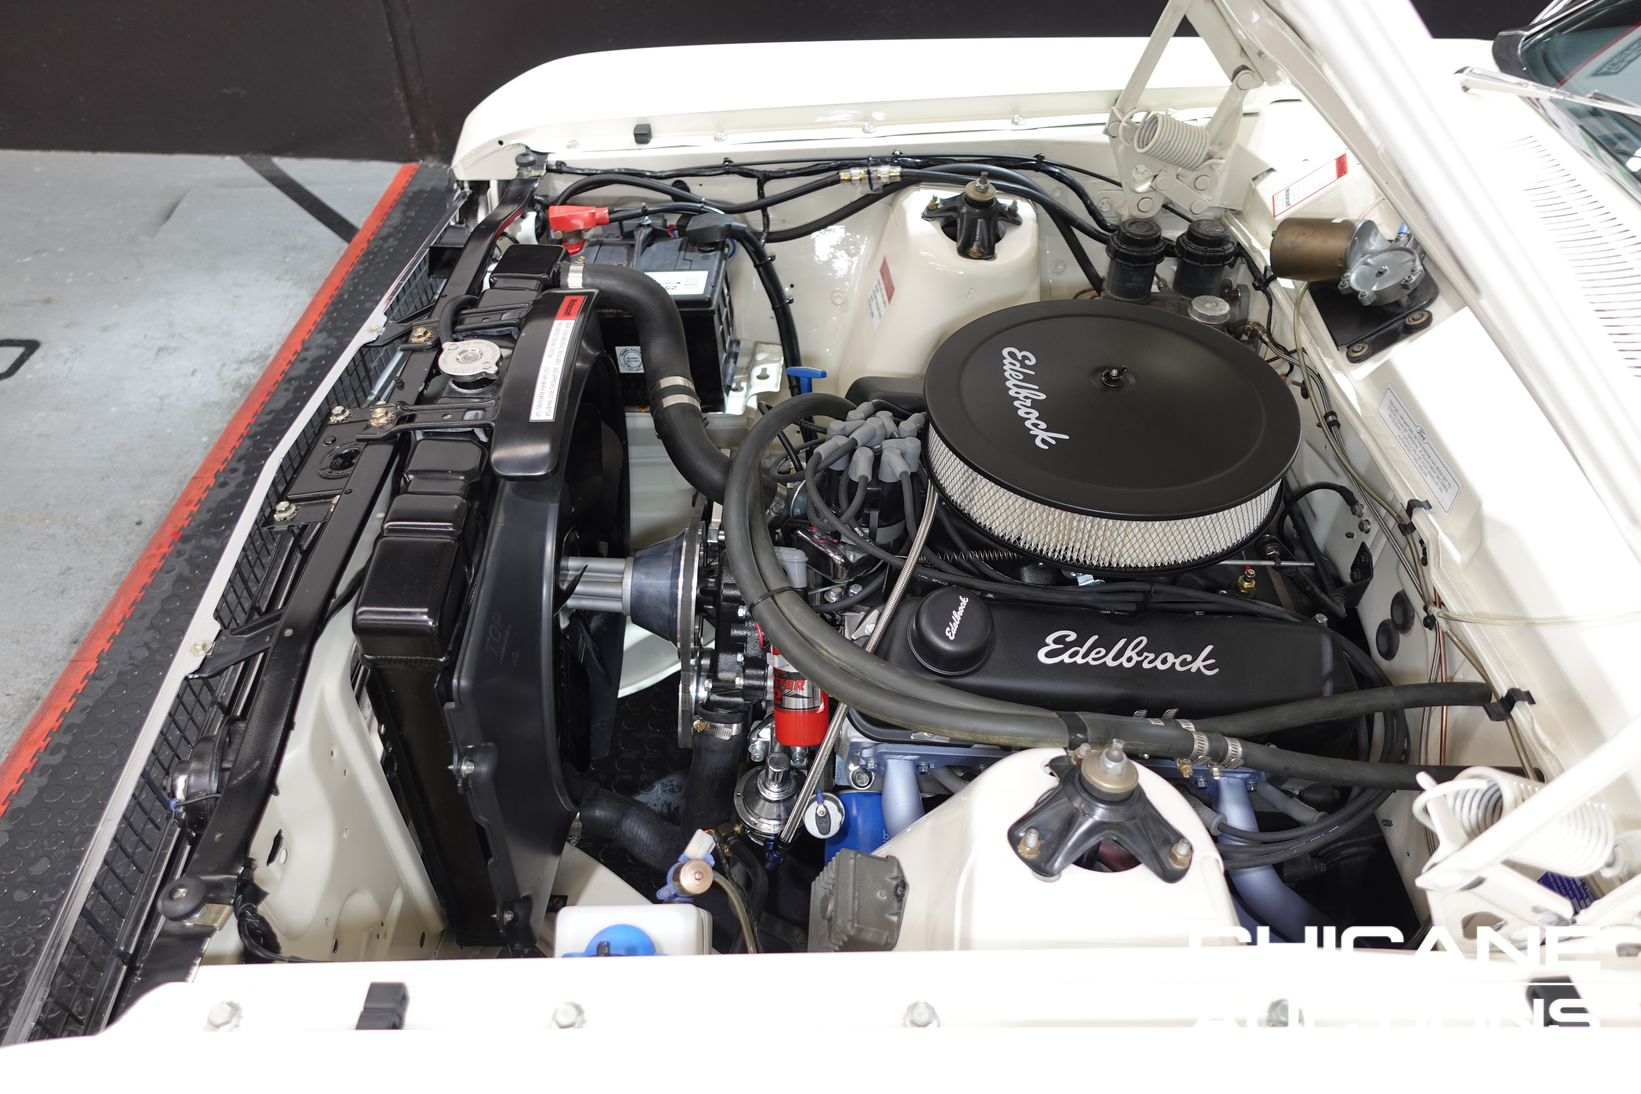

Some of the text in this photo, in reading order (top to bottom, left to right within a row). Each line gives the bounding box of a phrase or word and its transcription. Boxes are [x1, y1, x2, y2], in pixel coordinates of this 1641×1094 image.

[1001, 346, 1070, 450] Edelbrock
[945, 595, 969, 641] Edelbrock
[1036, 629, 1220, 676] Edelbrock
